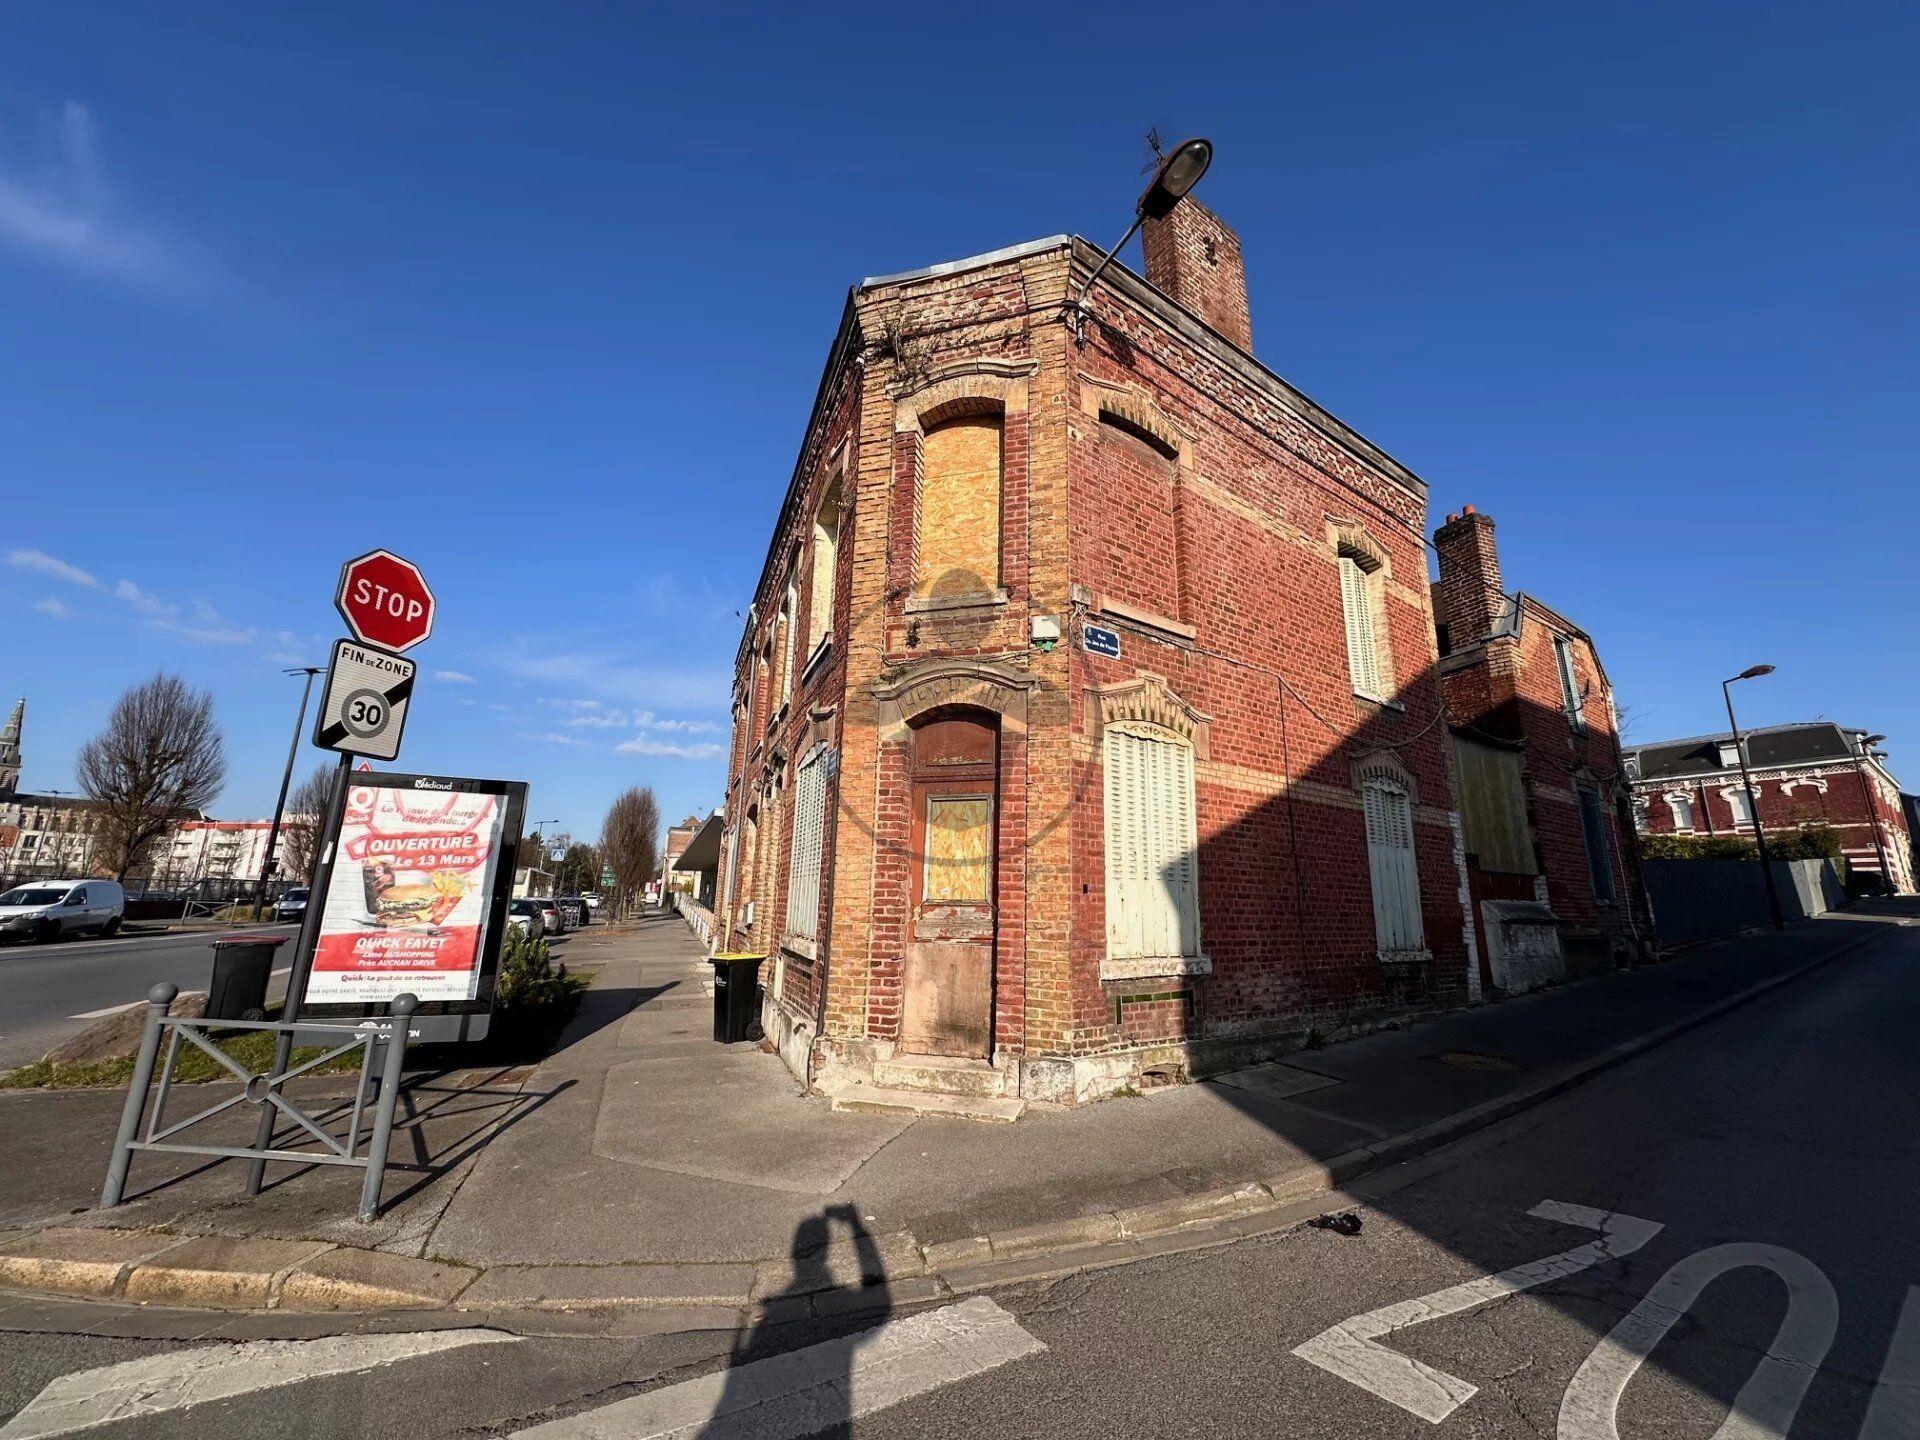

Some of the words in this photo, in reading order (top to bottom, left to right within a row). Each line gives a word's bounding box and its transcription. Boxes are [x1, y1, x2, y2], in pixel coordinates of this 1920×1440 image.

[354, 578, 423, 622] STOP
[341, 646, 365, 664] FIN
[366, 659, 375, 667] DE
[375, 657, 410, 676] ZONE
[350, 701, 381, 726] 30
[345, 814, 371, 824] Quick
[370, 836, 474, 852] OUVERTURE
[395, 856, 412, 867] Le
[416, 855, 436, 866] 13
[439, 854, 475, 865] Mars
[356, 937, 400, 950] QUICK
[404, 937, 448, 949] FAYET
[341, 974, 364, 982] Quick
